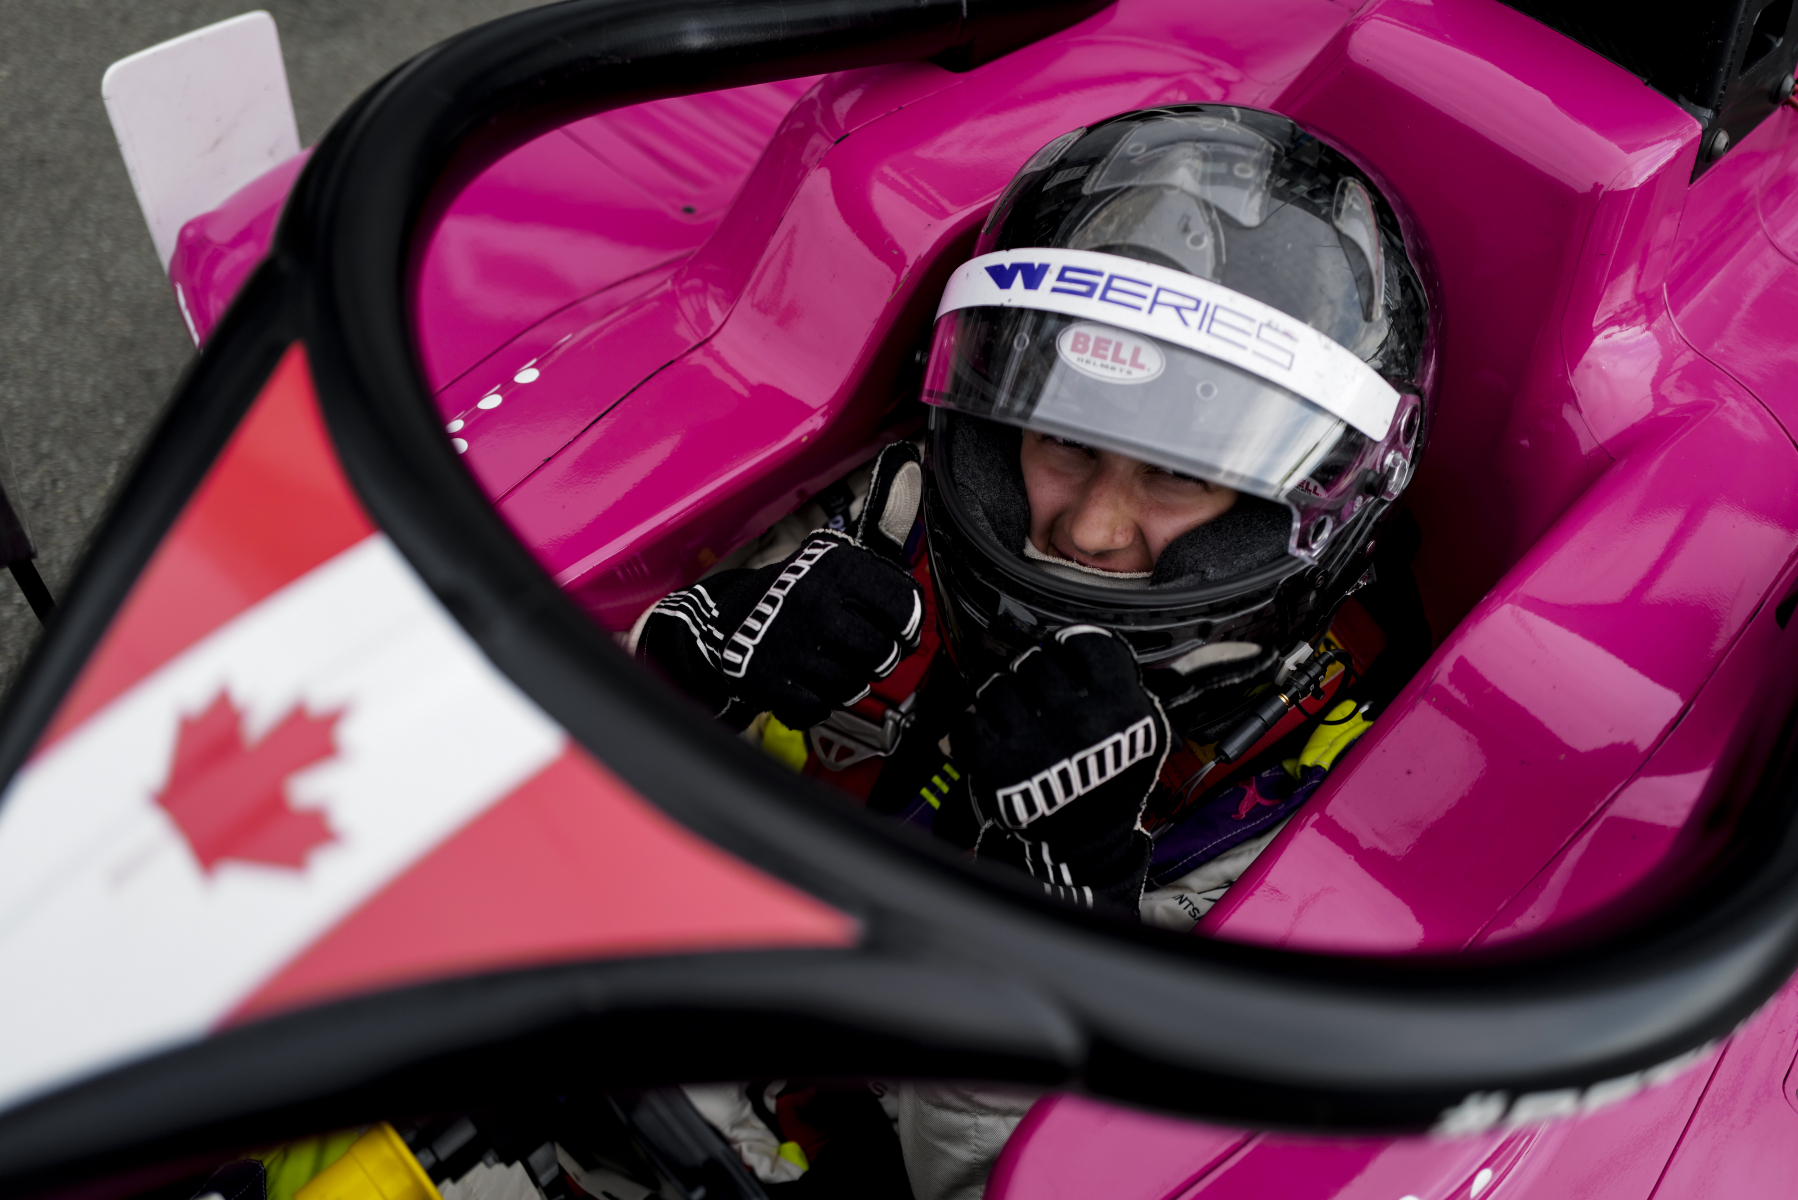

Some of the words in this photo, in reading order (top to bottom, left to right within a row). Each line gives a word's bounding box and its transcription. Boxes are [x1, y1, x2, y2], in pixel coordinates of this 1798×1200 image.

[1070, 330, 1146, 370] BELL
[1077, 357, 1133, 375] HELMETS
[1297, 479, 1320, 497] ELL
